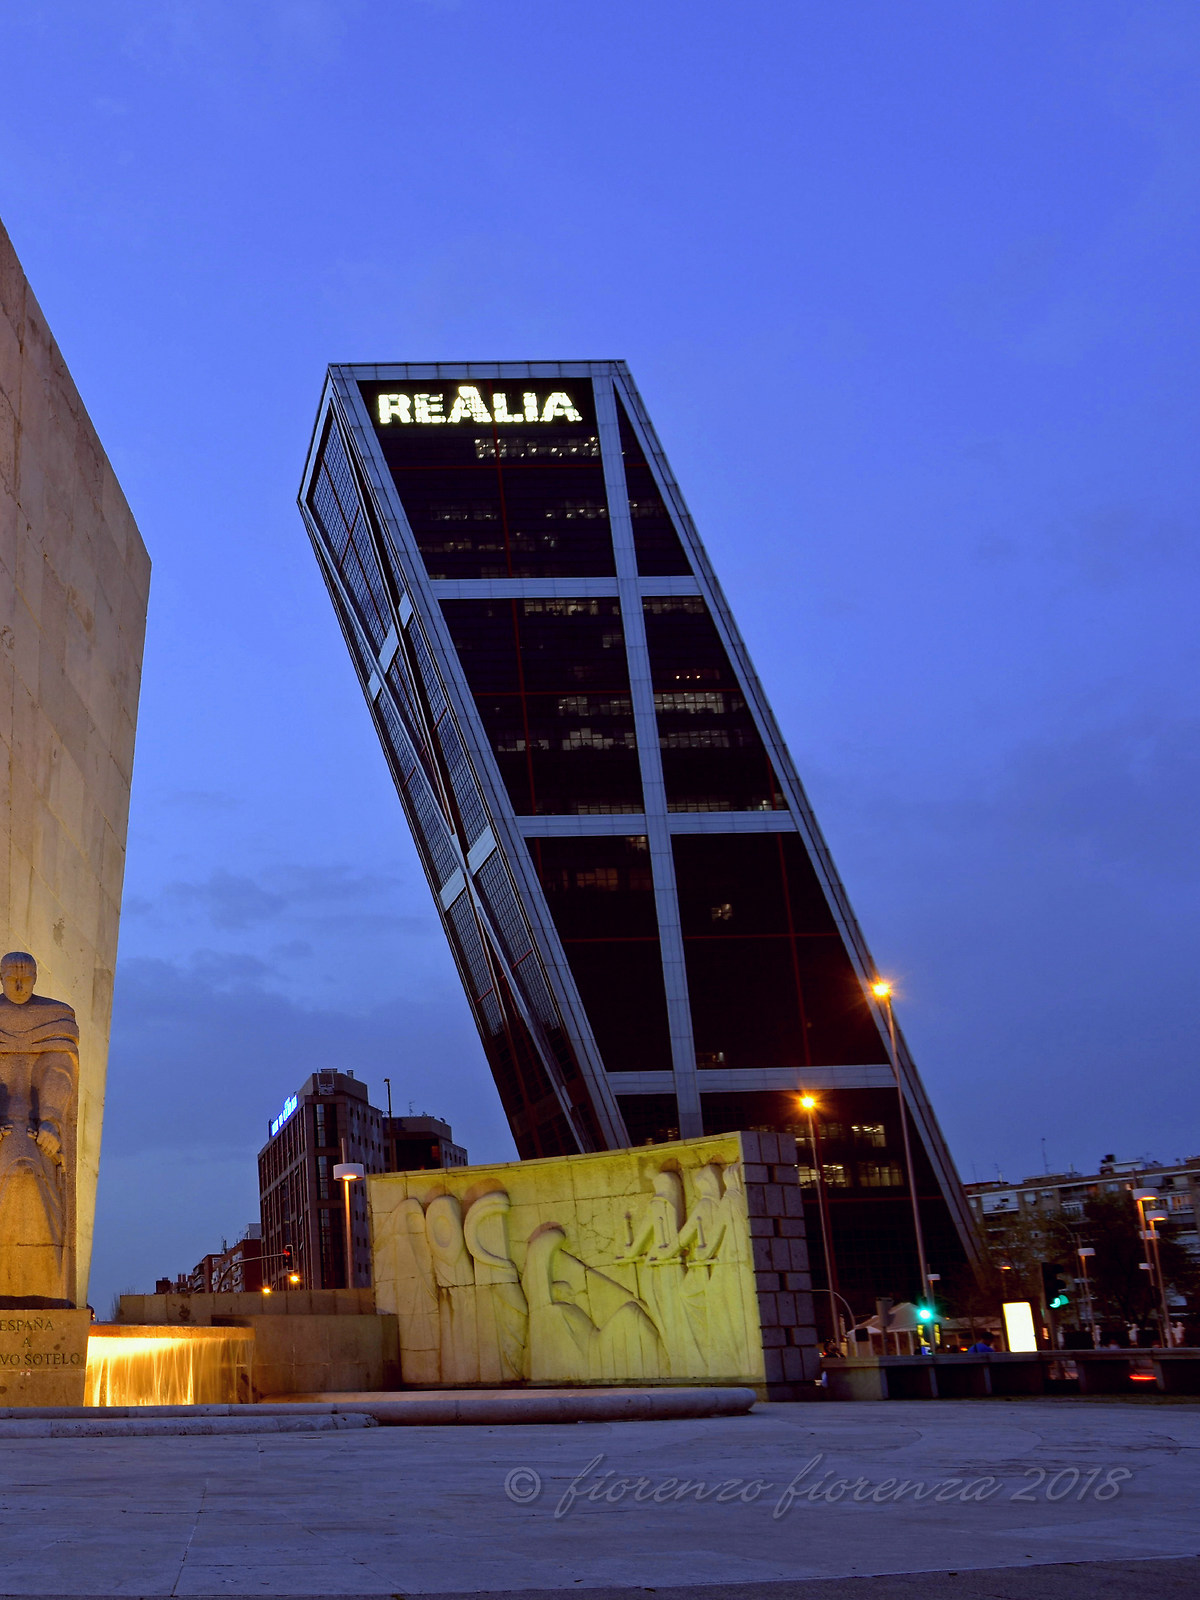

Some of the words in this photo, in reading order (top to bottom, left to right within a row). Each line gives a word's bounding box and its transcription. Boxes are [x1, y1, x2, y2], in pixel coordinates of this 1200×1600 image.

[378, 385, 582, 424] REALIA
[0, 1316, 55, 1331] ESPAÑA
[22, 1337, 32, 1348] A
[24, 1352, 80, 1366] SOTELO
